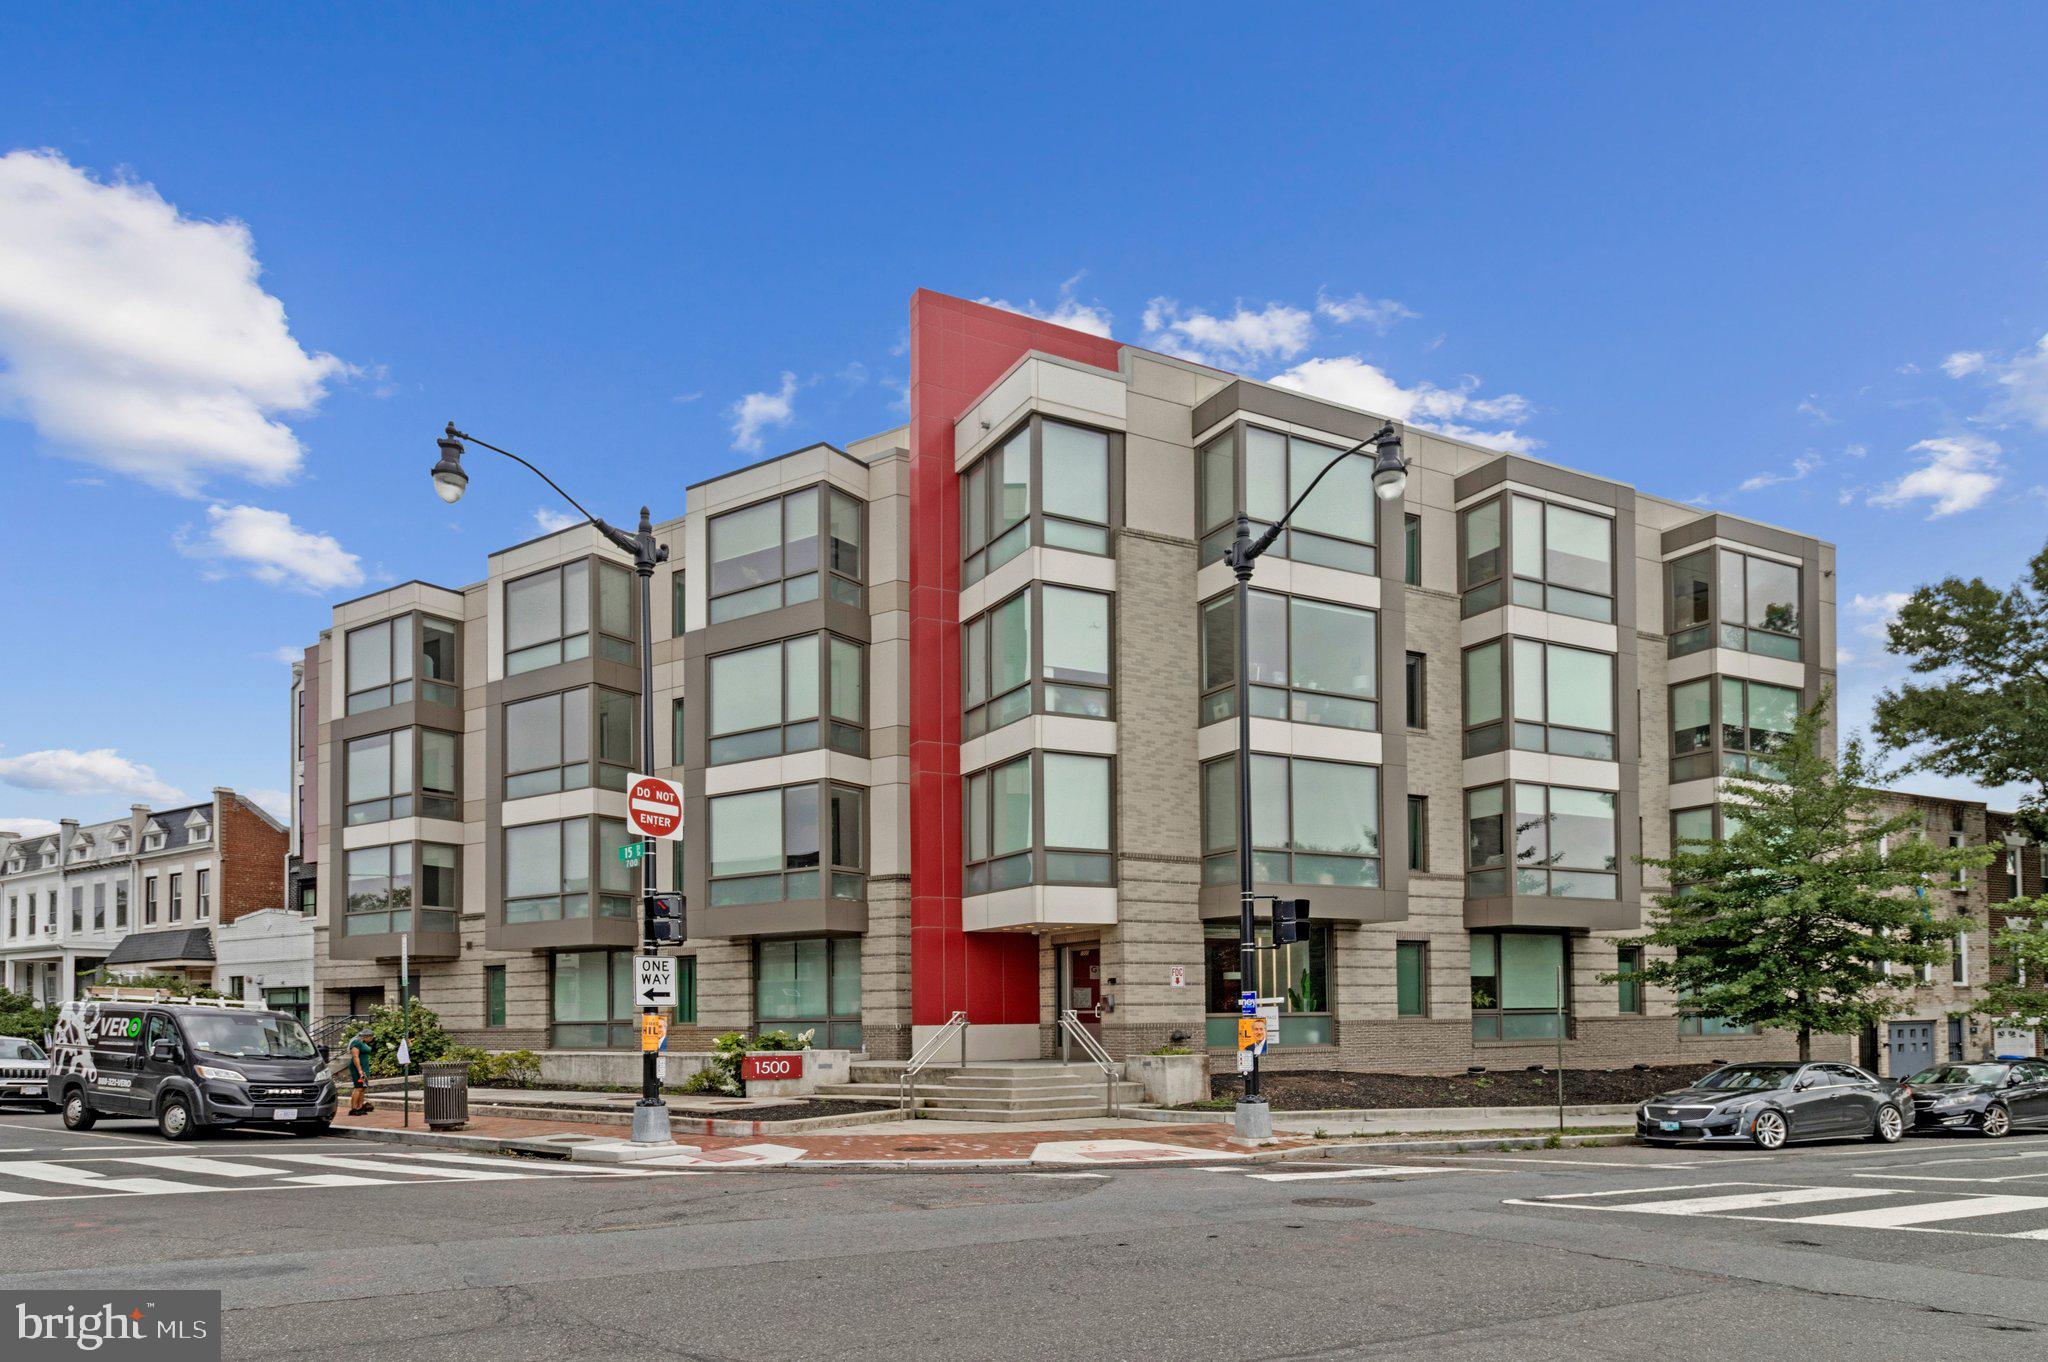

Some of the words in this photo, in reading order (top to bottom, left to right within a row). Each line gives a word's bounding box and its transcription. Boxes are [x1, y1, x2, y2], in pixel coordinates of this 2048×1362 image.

[637, 787, 650, 798] DO
[656, 790, 675, 802] NOT
[640, 814, 671, 827] ENTER
[624, 846, 633, 859] 15
[625, 858, 638, 868] 700
[642, 960, 670, 972] ONE
[1171, 967, 1183, 977] FDC
[641, 974, 671, 985] WAY
[100, 1016, 142, 1038] VERO
[755, 1061, 790, 1074] 1500
